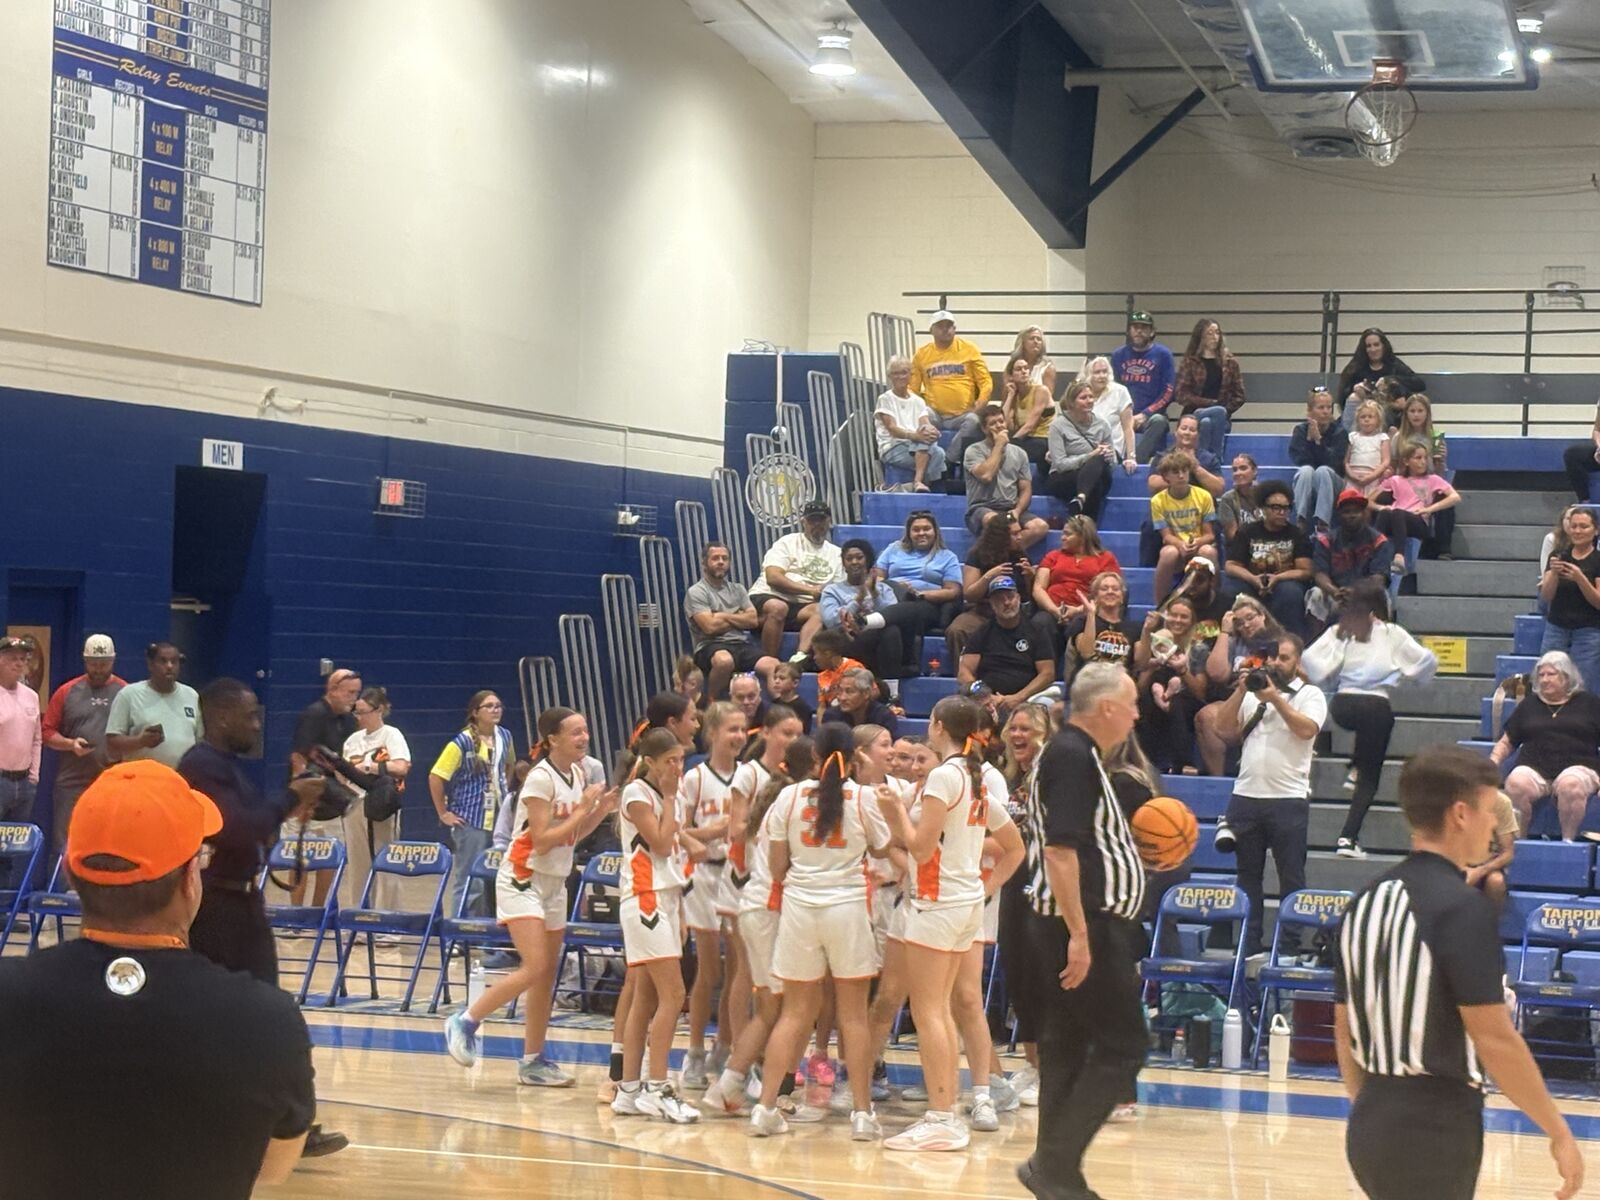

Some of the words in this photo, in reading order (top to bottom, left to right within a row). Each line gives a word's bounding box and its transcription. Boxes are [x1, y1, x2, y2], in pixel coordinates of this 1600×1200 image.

[77, 68, 93, 82] GIRLS
[119, 58, 161, 86] Relay
[166, 72, 211, 97] Events
[155, 139, 173, 156] RELAY
[153, 196, 171, 212] RELAY
[152, 256, 170, 271] RELAY
[1121, 358, 1156, 371] FLORIDA
[212, 443, 235, 467] MEN
[389, 844, 440, 855] TARPON
[1177, 887, 1236, 899] TARPON
[1175, 896, 1234, 907] BOOSTERS
